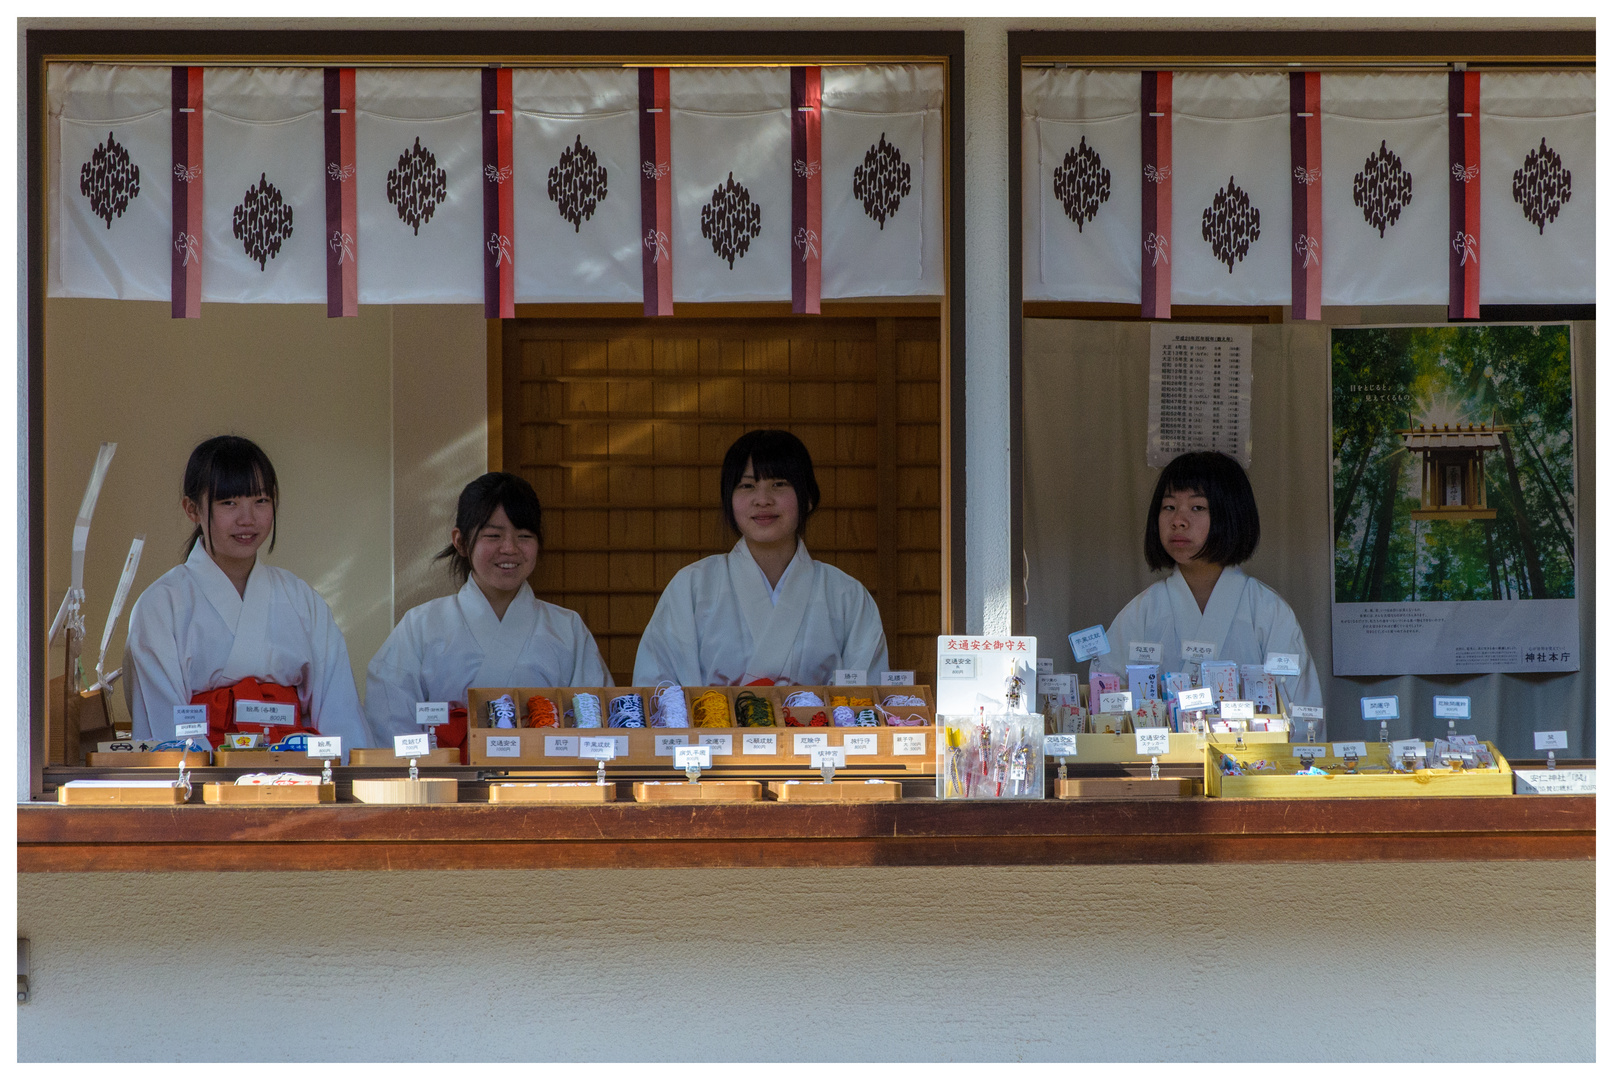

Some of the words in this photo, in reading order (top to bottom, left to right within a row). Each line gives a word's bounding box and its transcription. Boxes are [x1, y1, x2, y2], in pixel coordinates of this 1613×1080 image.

[1365, 394, 1410, 402] 見えてくるもの
[1075, 632, 1101, 645] 学業成就
[948, 639, 1027, 651] 交通安全御守矢
[1135, 646, 1155, 654] 勾玉守
[1185, 646, 1212, 654] かえる守
[1525, 652, 1571, 663] 神社本庁
[1530, 774, 1567, 783] 安仁神社
